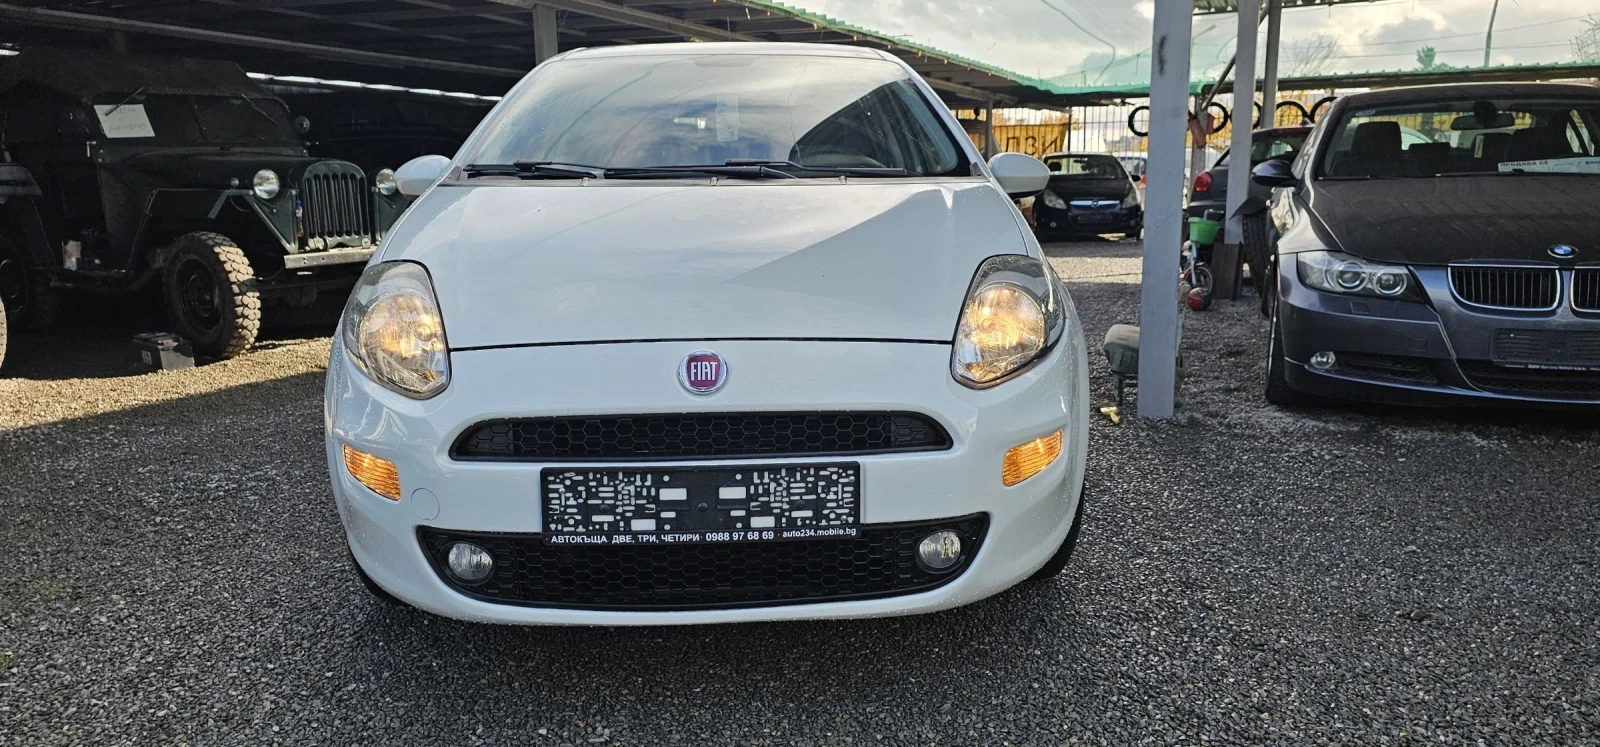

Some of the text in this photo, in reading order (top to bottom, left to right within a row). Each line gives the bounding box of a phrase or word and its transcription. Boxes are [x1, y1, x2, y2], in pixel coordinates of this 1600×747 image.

[690, 361, 718, 381] FIAT
[551, 527, 857, 544] АВТОКЪЩА ДВЕ, ТРИ, ЧЕТИРИ 0988 97 68 69 auto234.mobile.bg
